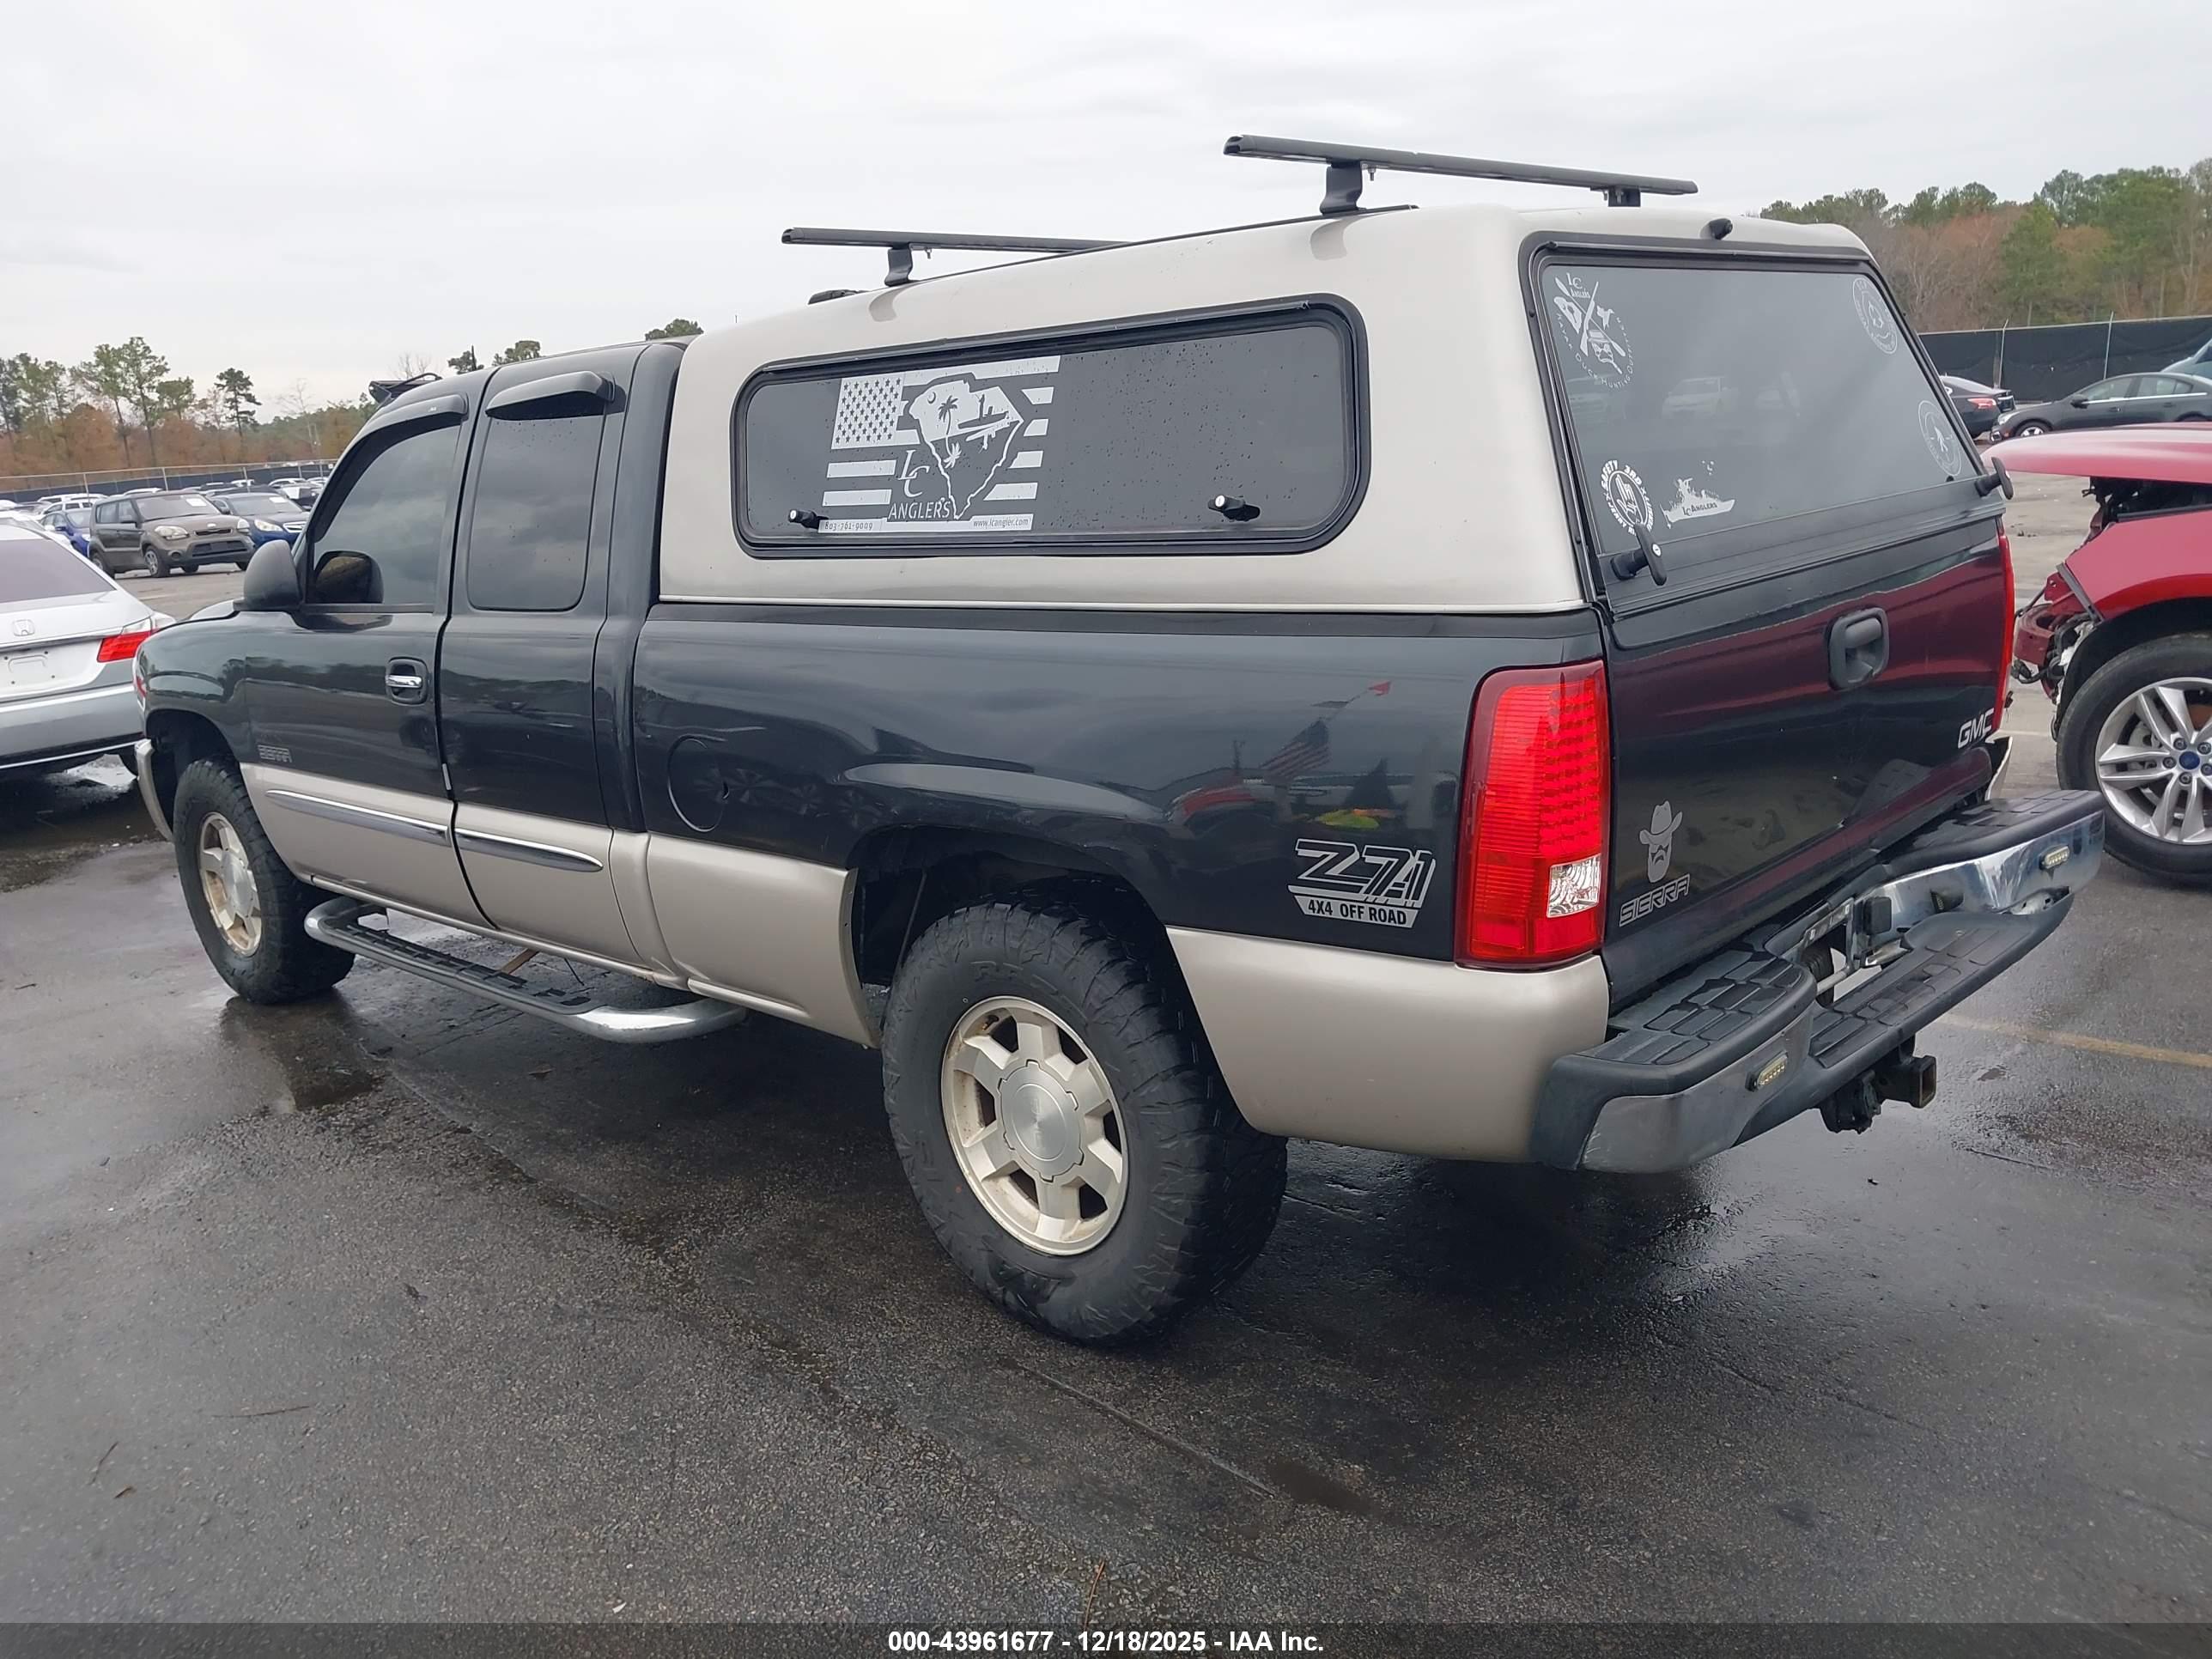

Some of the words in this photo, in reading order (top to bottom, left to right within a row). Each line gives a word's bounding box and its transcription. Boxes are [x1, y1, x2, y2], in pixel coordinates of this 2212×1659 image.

[1601, 459, 1619, 489] SAFETY
[1624, 465, 1642, 485] 3RD
[1958, 708, 1995, 749] GMC
[1288, 838, 1436, 908] Z71
[1340, 903, 1365, 920] OFF
[1369, 907, 1407, 925] ROAD
[1620, 873, 1690, 927] SIERRA
